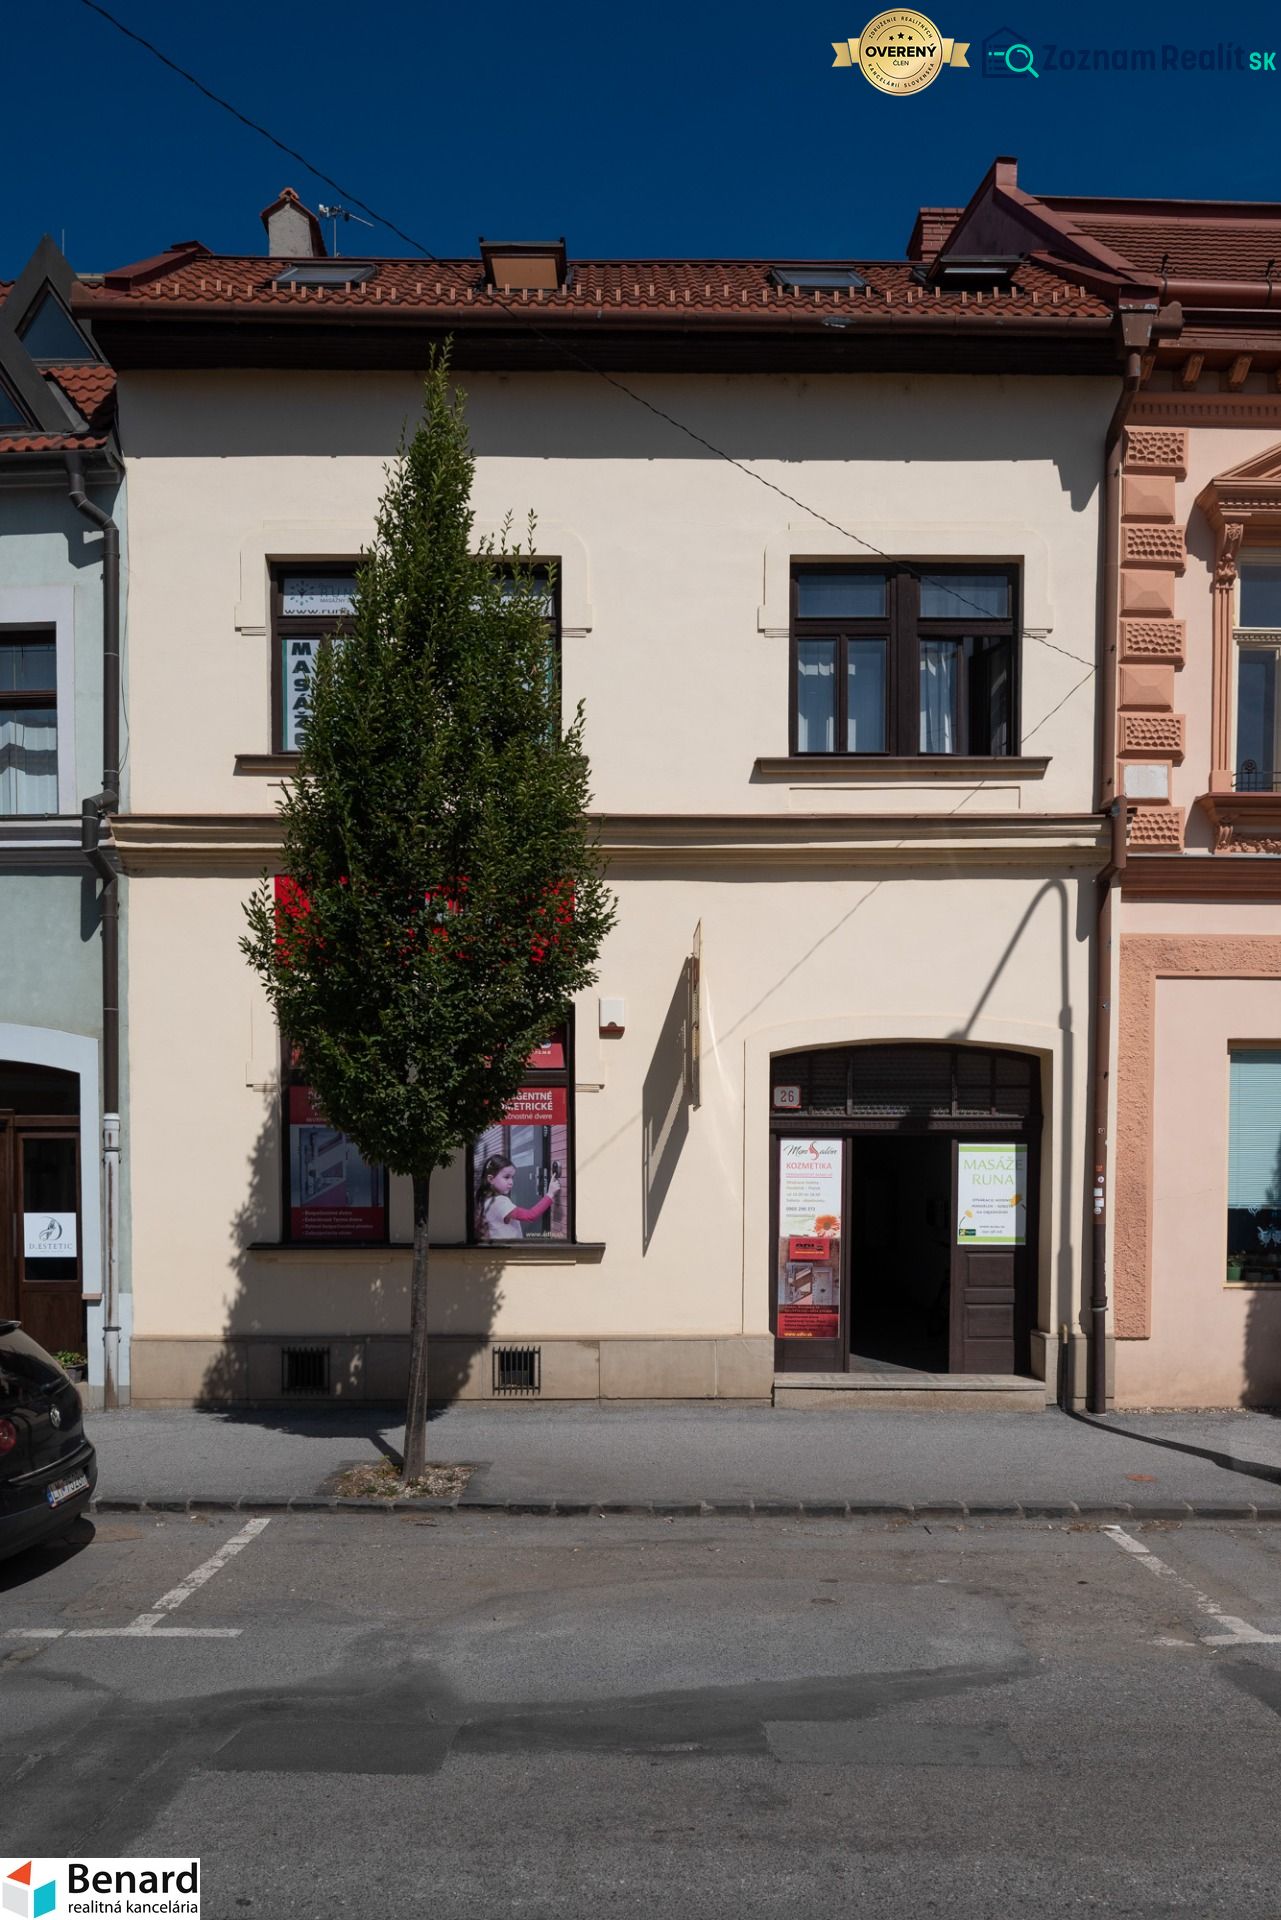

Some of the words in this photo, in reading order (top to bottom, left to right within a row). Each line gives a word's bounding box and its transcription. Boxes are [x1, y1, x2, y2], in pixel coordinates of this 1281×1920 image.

[780, 1090, 794, 1103] 26
[786, 1162, 832, 1170] KOZMETIKA
[963, 1156, 1024, 1170] MASÁŽE
[972, 1174, 1014, 1185] RUNA
